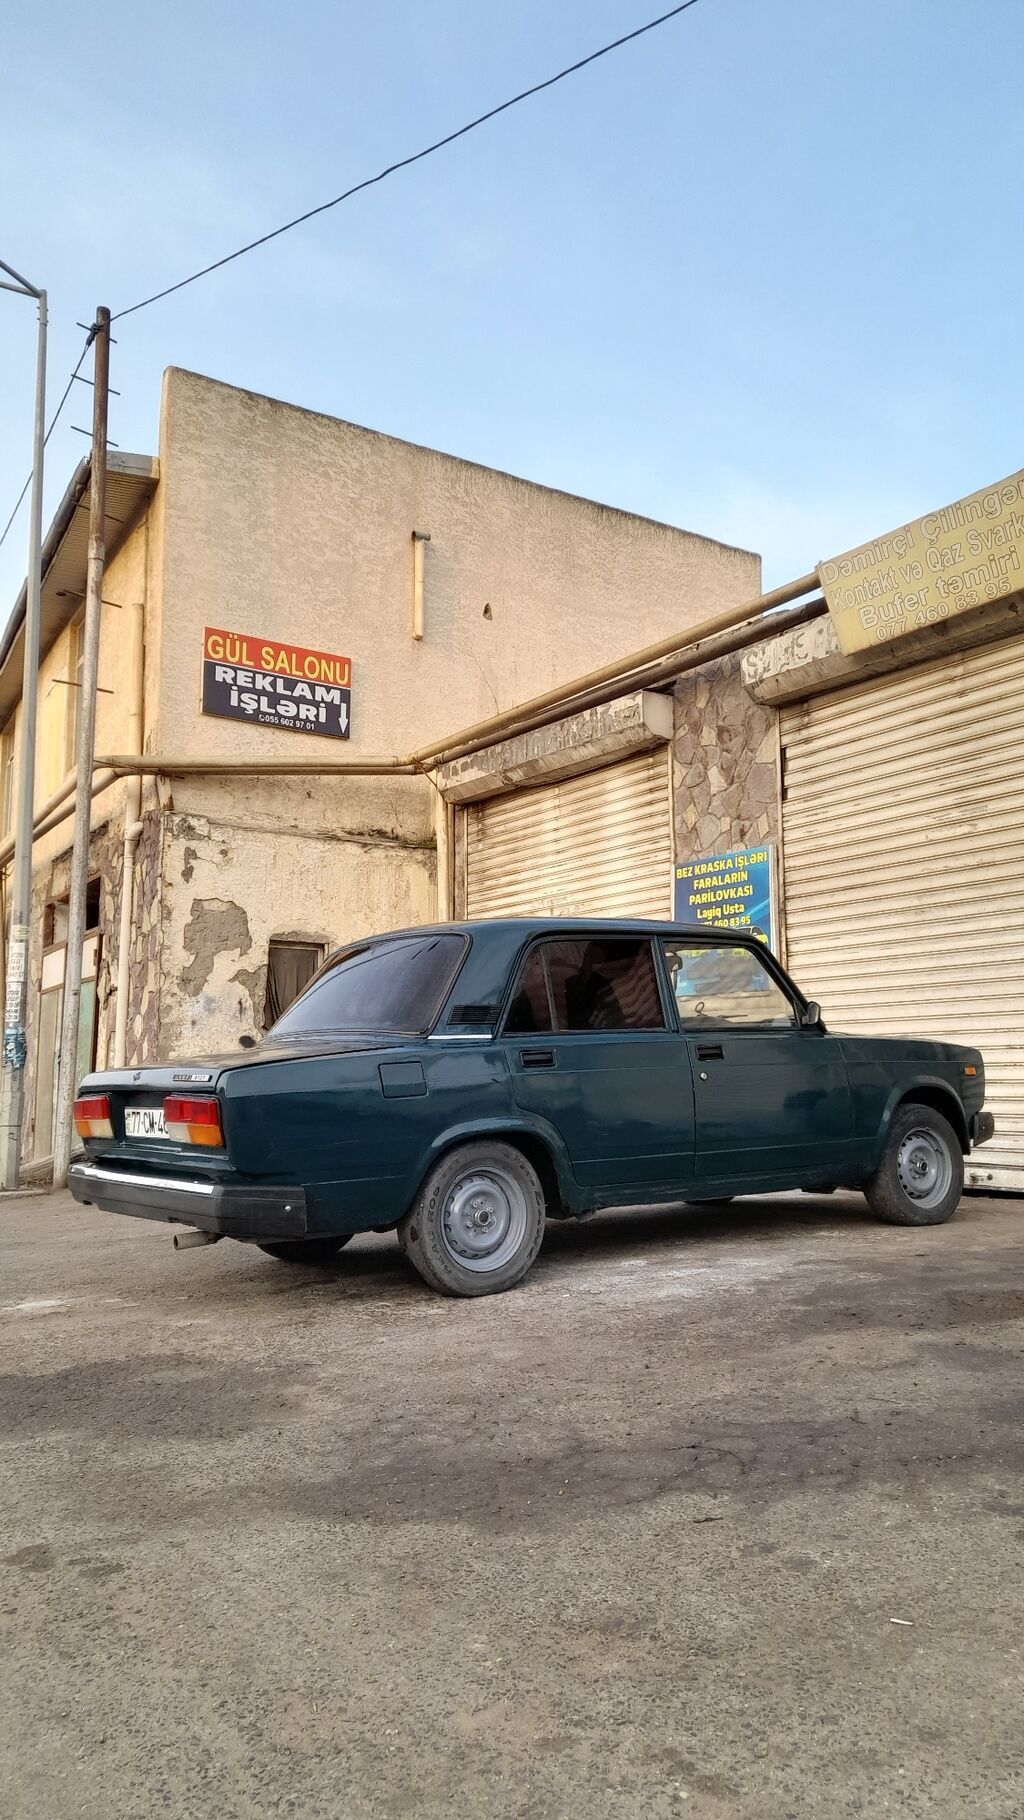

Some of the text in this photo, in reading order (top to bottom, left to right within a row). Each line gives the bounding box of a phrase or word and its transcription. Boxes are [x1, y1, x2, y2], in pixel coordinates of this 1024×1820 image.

[820, 526, 915, 585] Dəmirçi
[830, 567, 899, 613] Kontakt
[900, 560, 923, 583] və
[925, 542, 966, 574] Qaz
[857, 545, 1021, 631] Bufer təmiri
[876, 576, 1012, 641] 077 460 83 95
[207, 634, 349, 685] GÜL SALONU
[215, 665, 341, 705] REKLAM
[265, 715, 315, 731] 055 602 97 01
[676, 866, 694, 879] BEZ
[694, 858, 733, 876] KRASKA
[693, 870, 748, 890] FARALARIN
[689, 884, 753, 906] PARİLOVKASI
[696, 903, 745, 920] Layiq Usta
[729, 917, 739, 927] 83
[740, 915, 751, 925] 95
